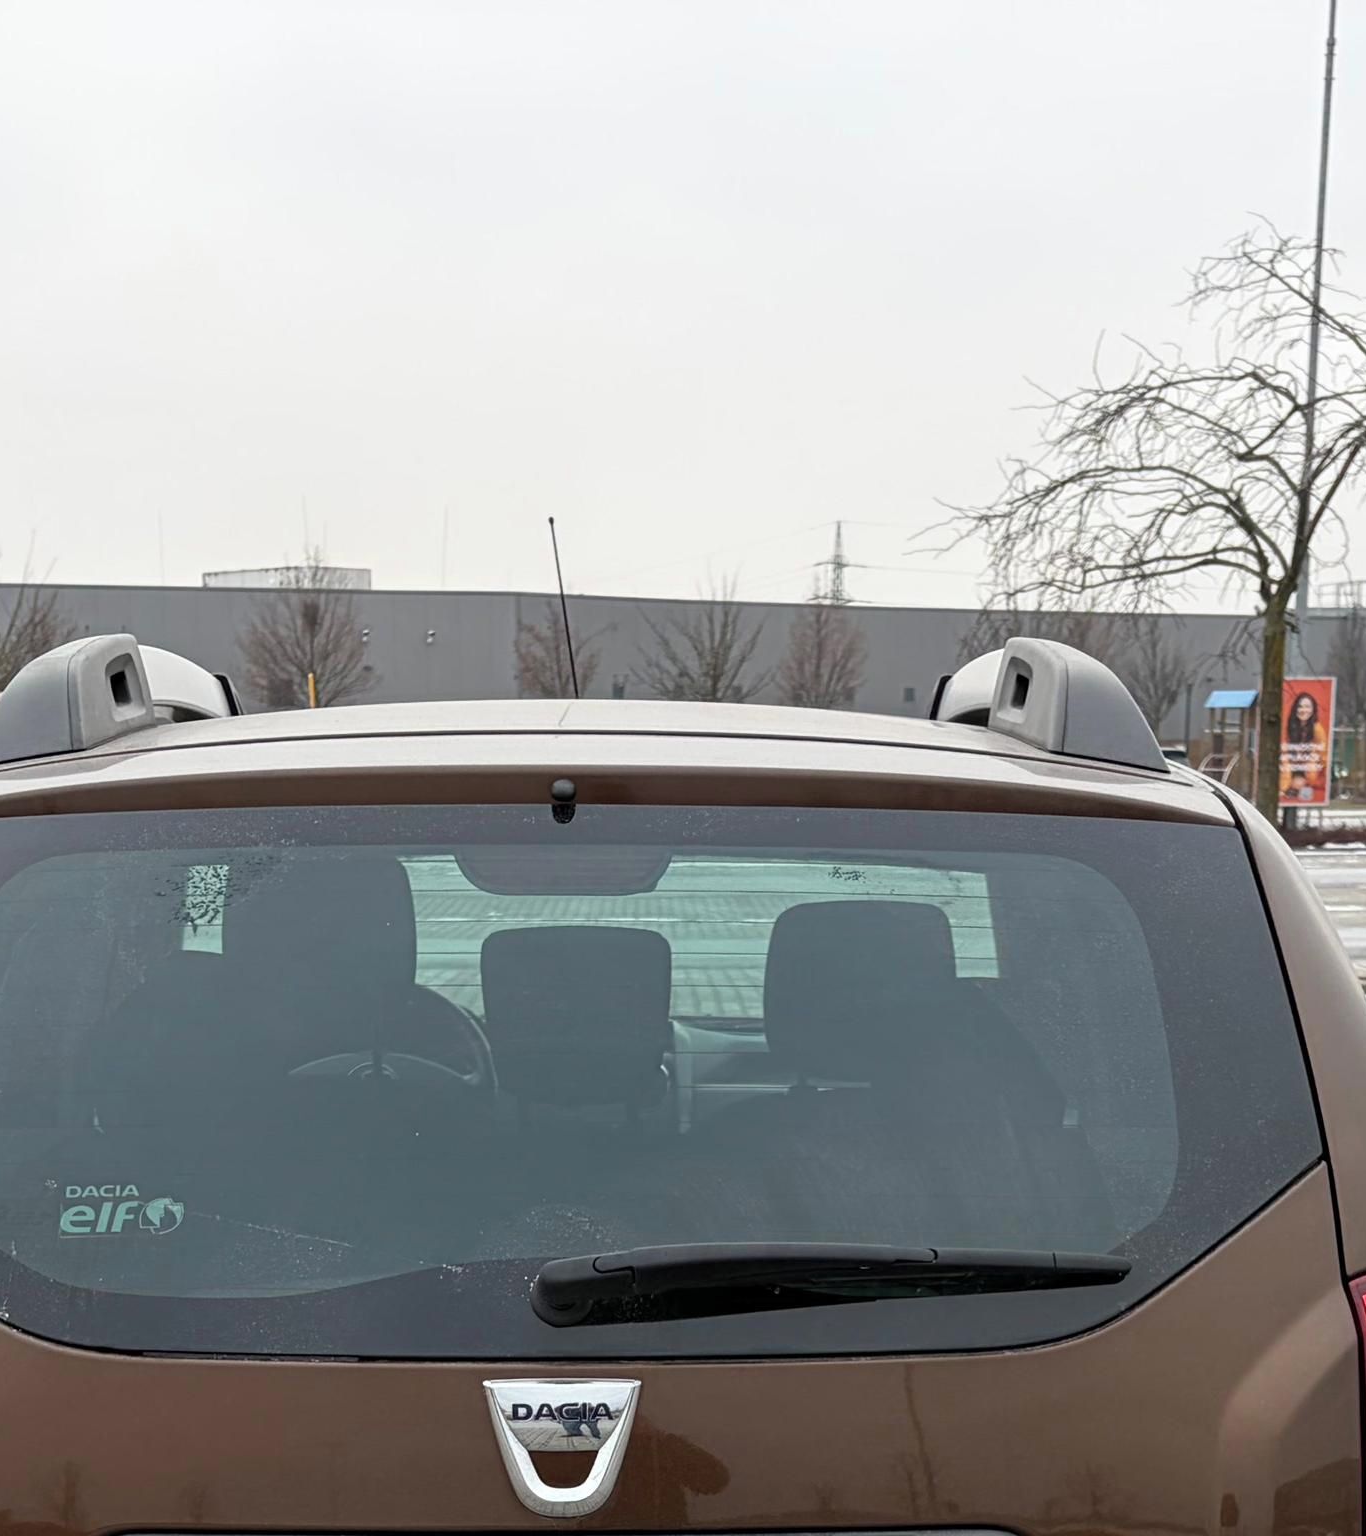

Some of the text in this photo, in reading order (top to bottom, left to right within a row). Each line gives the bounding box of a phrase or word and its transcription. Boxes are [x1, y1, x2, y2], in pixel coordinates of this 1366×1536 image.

[65, 1184, 139, 1198] DACIA
[59, 1201, 139, 1233] elf
[511, 1403, 614, 1421] DACIA
